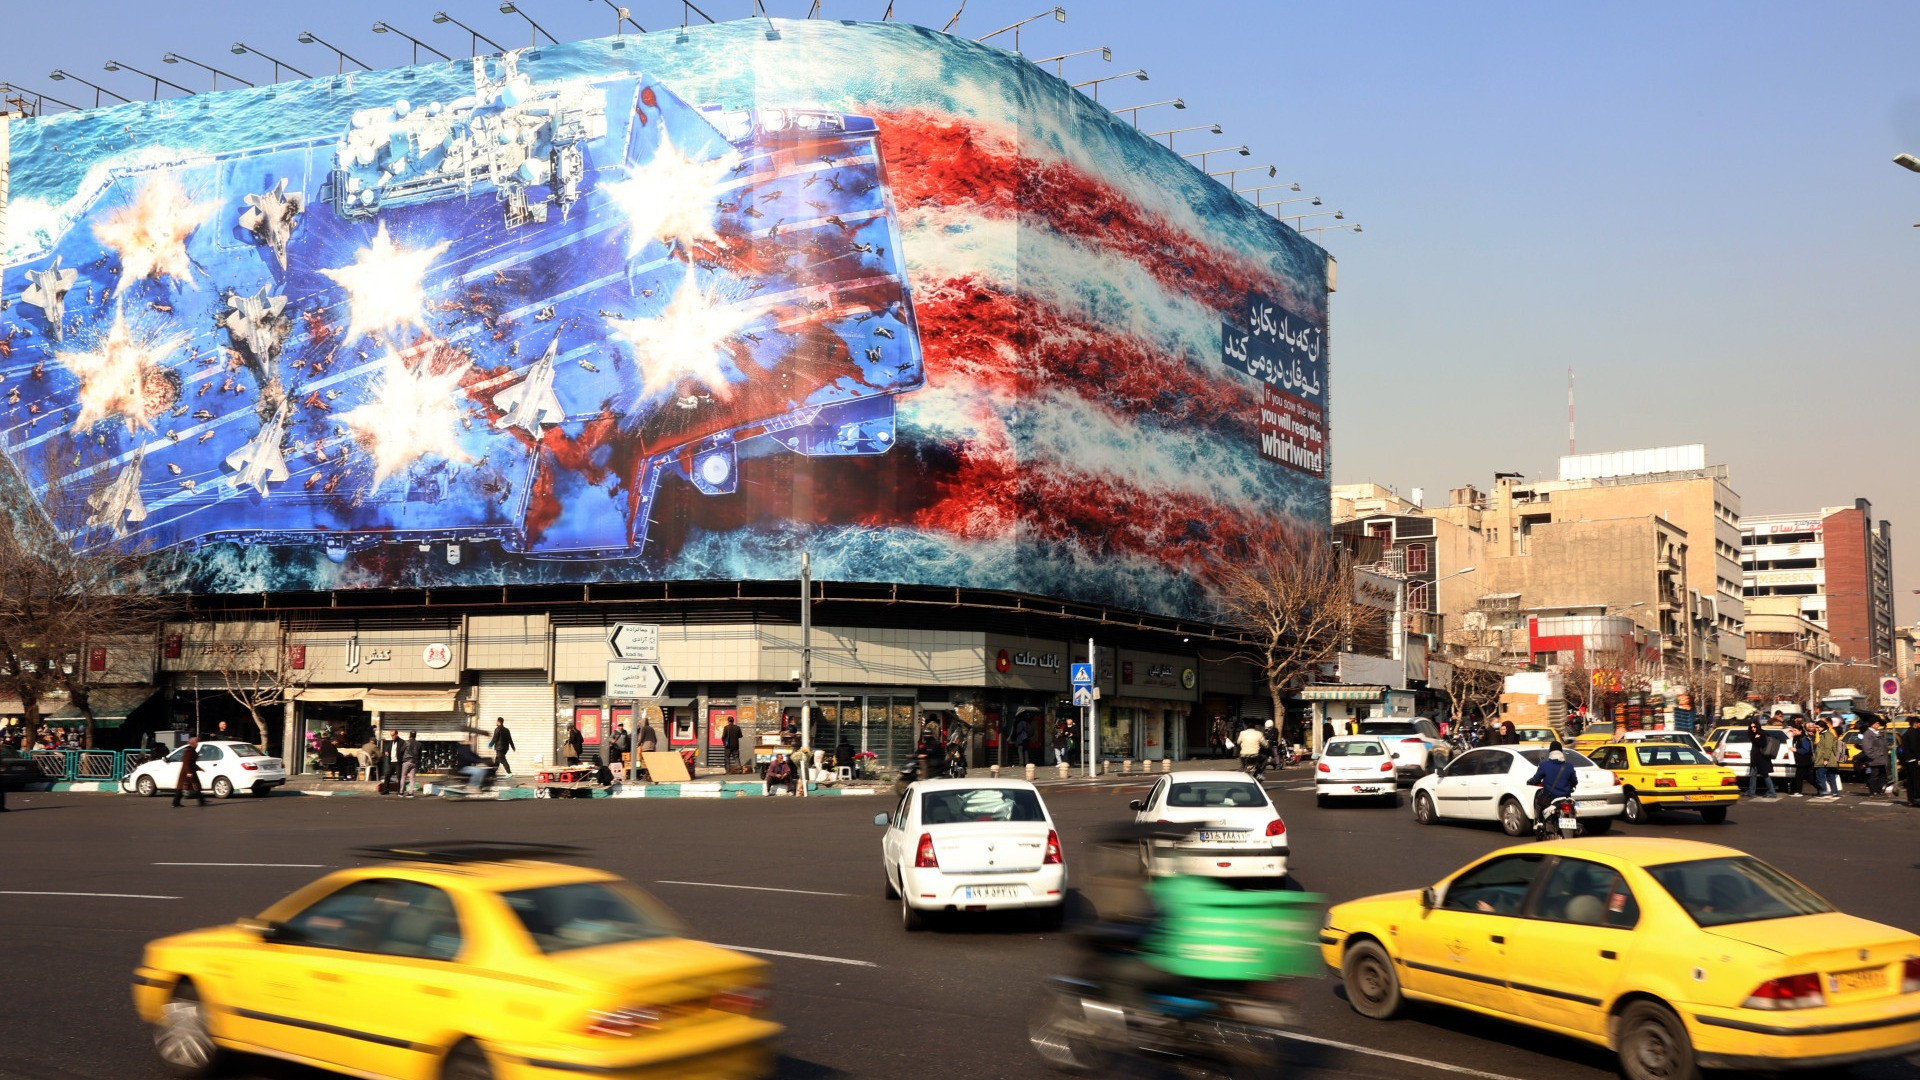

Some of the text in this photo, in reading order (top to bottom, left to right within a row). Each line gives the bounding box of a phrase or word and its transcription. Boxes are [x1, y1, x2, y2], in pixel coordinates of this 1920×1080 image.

[1250, 303, 1276, 344] بکارد
[1279, 315, 1295, 353] باد
[1283, 359, 1320, 398] طوفان
[1265, 388, 1271, 402] If
[1271, 394, 1283, 406] you
[1284, 399, 1296, 412] sow
[1297, 402, 1307, 417] the
[1261, 407, 1322, 443] you will reap the
[1261, 429, 1322, 472] whirlwind
[364, 648, 391, 665] کفش
[1015, 651, 1037, 666] ملت
